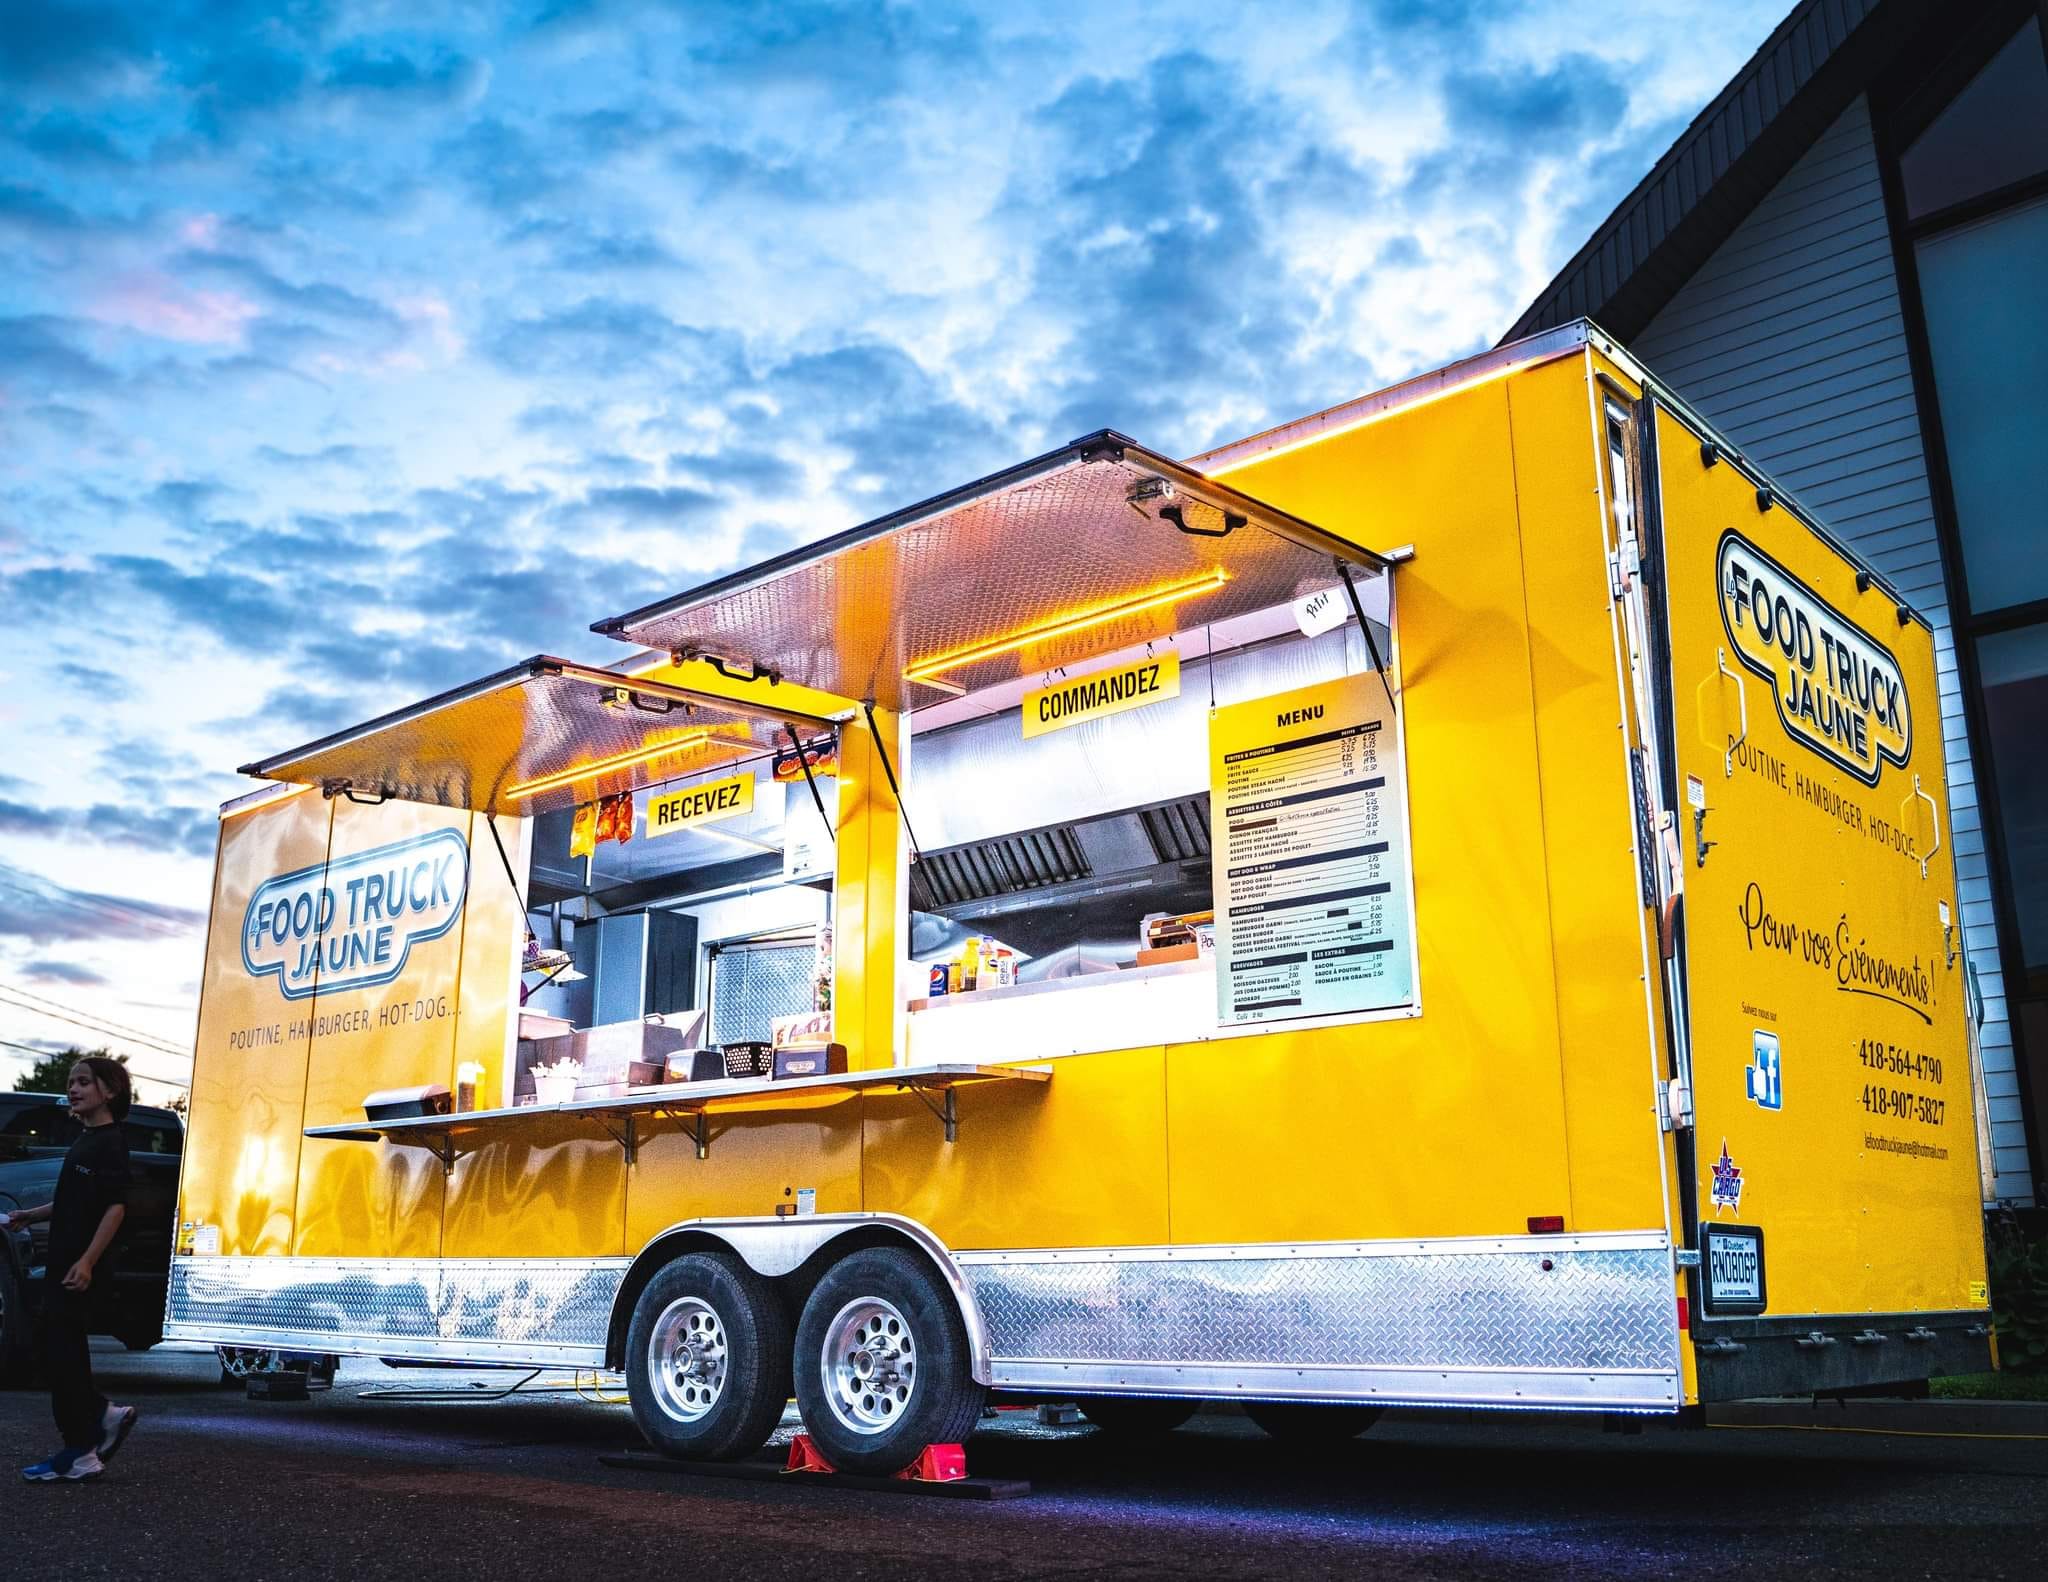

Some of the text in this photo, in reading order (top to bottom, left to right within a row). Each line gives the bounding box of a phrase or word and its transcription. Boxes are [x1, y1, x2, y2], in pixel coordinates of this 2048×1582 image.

[1731, 560, 1815, 672] FOOD
[1819, 627, 1904, 739] TRUCK
[1039, 664, 1160, 722] COMMANDEZ
[1277, 703, 1324, 728] MENU
[1785, 669, 1868, 760] JAUNE
[1228, 777, 1249, 785] POUTINE
[1228, 785, 1250, 793] POUTINE
[1228, 792, 1250, 800] POUTINE
[659, 784, 742, 826] RECEVEZ
[1795, 771, 1867, 837] HAMBURGER,
[1265, 831, 1298, 840] HAMBURGER
[255, 853, 455, 950] FOOD TRUCK
[1248, 891, 1267, 899] POULET
[1232, 916, 1265, 925] HAMBURGER
[1739, 882, 1799, 955] Pour
[1802, 928, 1834, 970] vos
[1232, 924, 1265, 932] HAMBURGER
[1253, 930, 1274, 938] BURGER
[1232, 940, 1252, 948] CHEESE
[1253, 937, 1274, 945] BURGER
[1233, 947, 1253, 955] BURGER
[1277, 941, 1301, 949] FESTIVAL
[290, 925, 393, 980] JAUNE
[1338, 966, 1361, 974] POUTINE
[1234, 980, 1256, 988] BOISSON
[1315, 977, 1341, 985] FROMAGE
[1234, 995, 1260, 1003] GATORADE
[229, 996, 463, 1051] POUTINE, HAMBURGER, HOT-DOG...
[1859, 1039, 1942, 1085] 418-564-4790
[1862, 1084, 1945, 1126] 418-907-5827
[1712, 1176, 1741, 1197] CARGO
